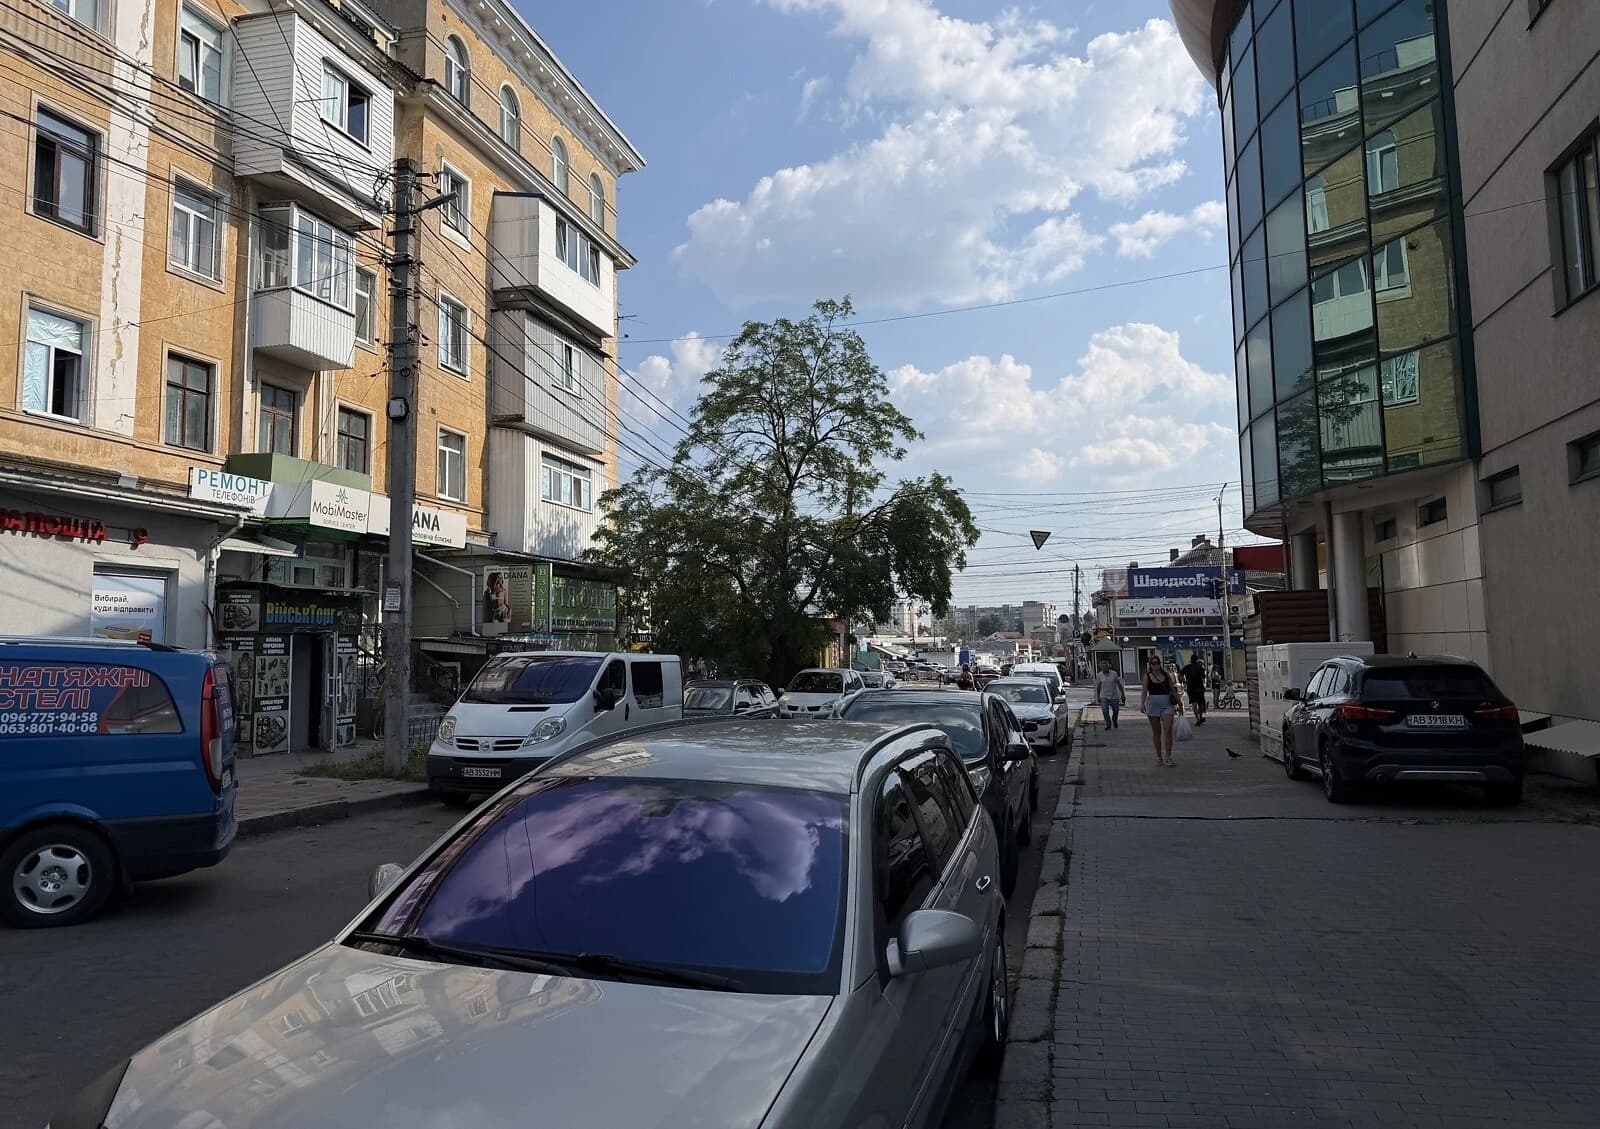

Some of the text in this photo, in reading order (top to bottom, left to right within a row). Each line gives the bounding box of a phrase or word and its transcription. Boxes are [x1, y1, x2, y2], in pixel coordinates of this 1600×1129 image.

[198, 469, 269, 497] РЕМОНТ
[211, 489, 256, 505] ТЕЛЕФОНІВ
[313, 501, 367, 522] MobiMaster
[412, 510, 440, 532] ANA
[26, 511, 108, 541] ПОШТА
[503, 571, 529, 580] DIANA
[95, 595, 129, 603] Вибирай,
[539, 568, 547, 626] ВЗУТТЯ
[94, 605, 154, 615] куди відправити
[1149, 607, 1205, 615] ЗООМАГАЗИН
[1189, 640, 1225, 648] КИЇВСТА
[0, 666, 151, 688] НАТЯЖНІ
[0, 688, 91, 710] СТЕЛІ
